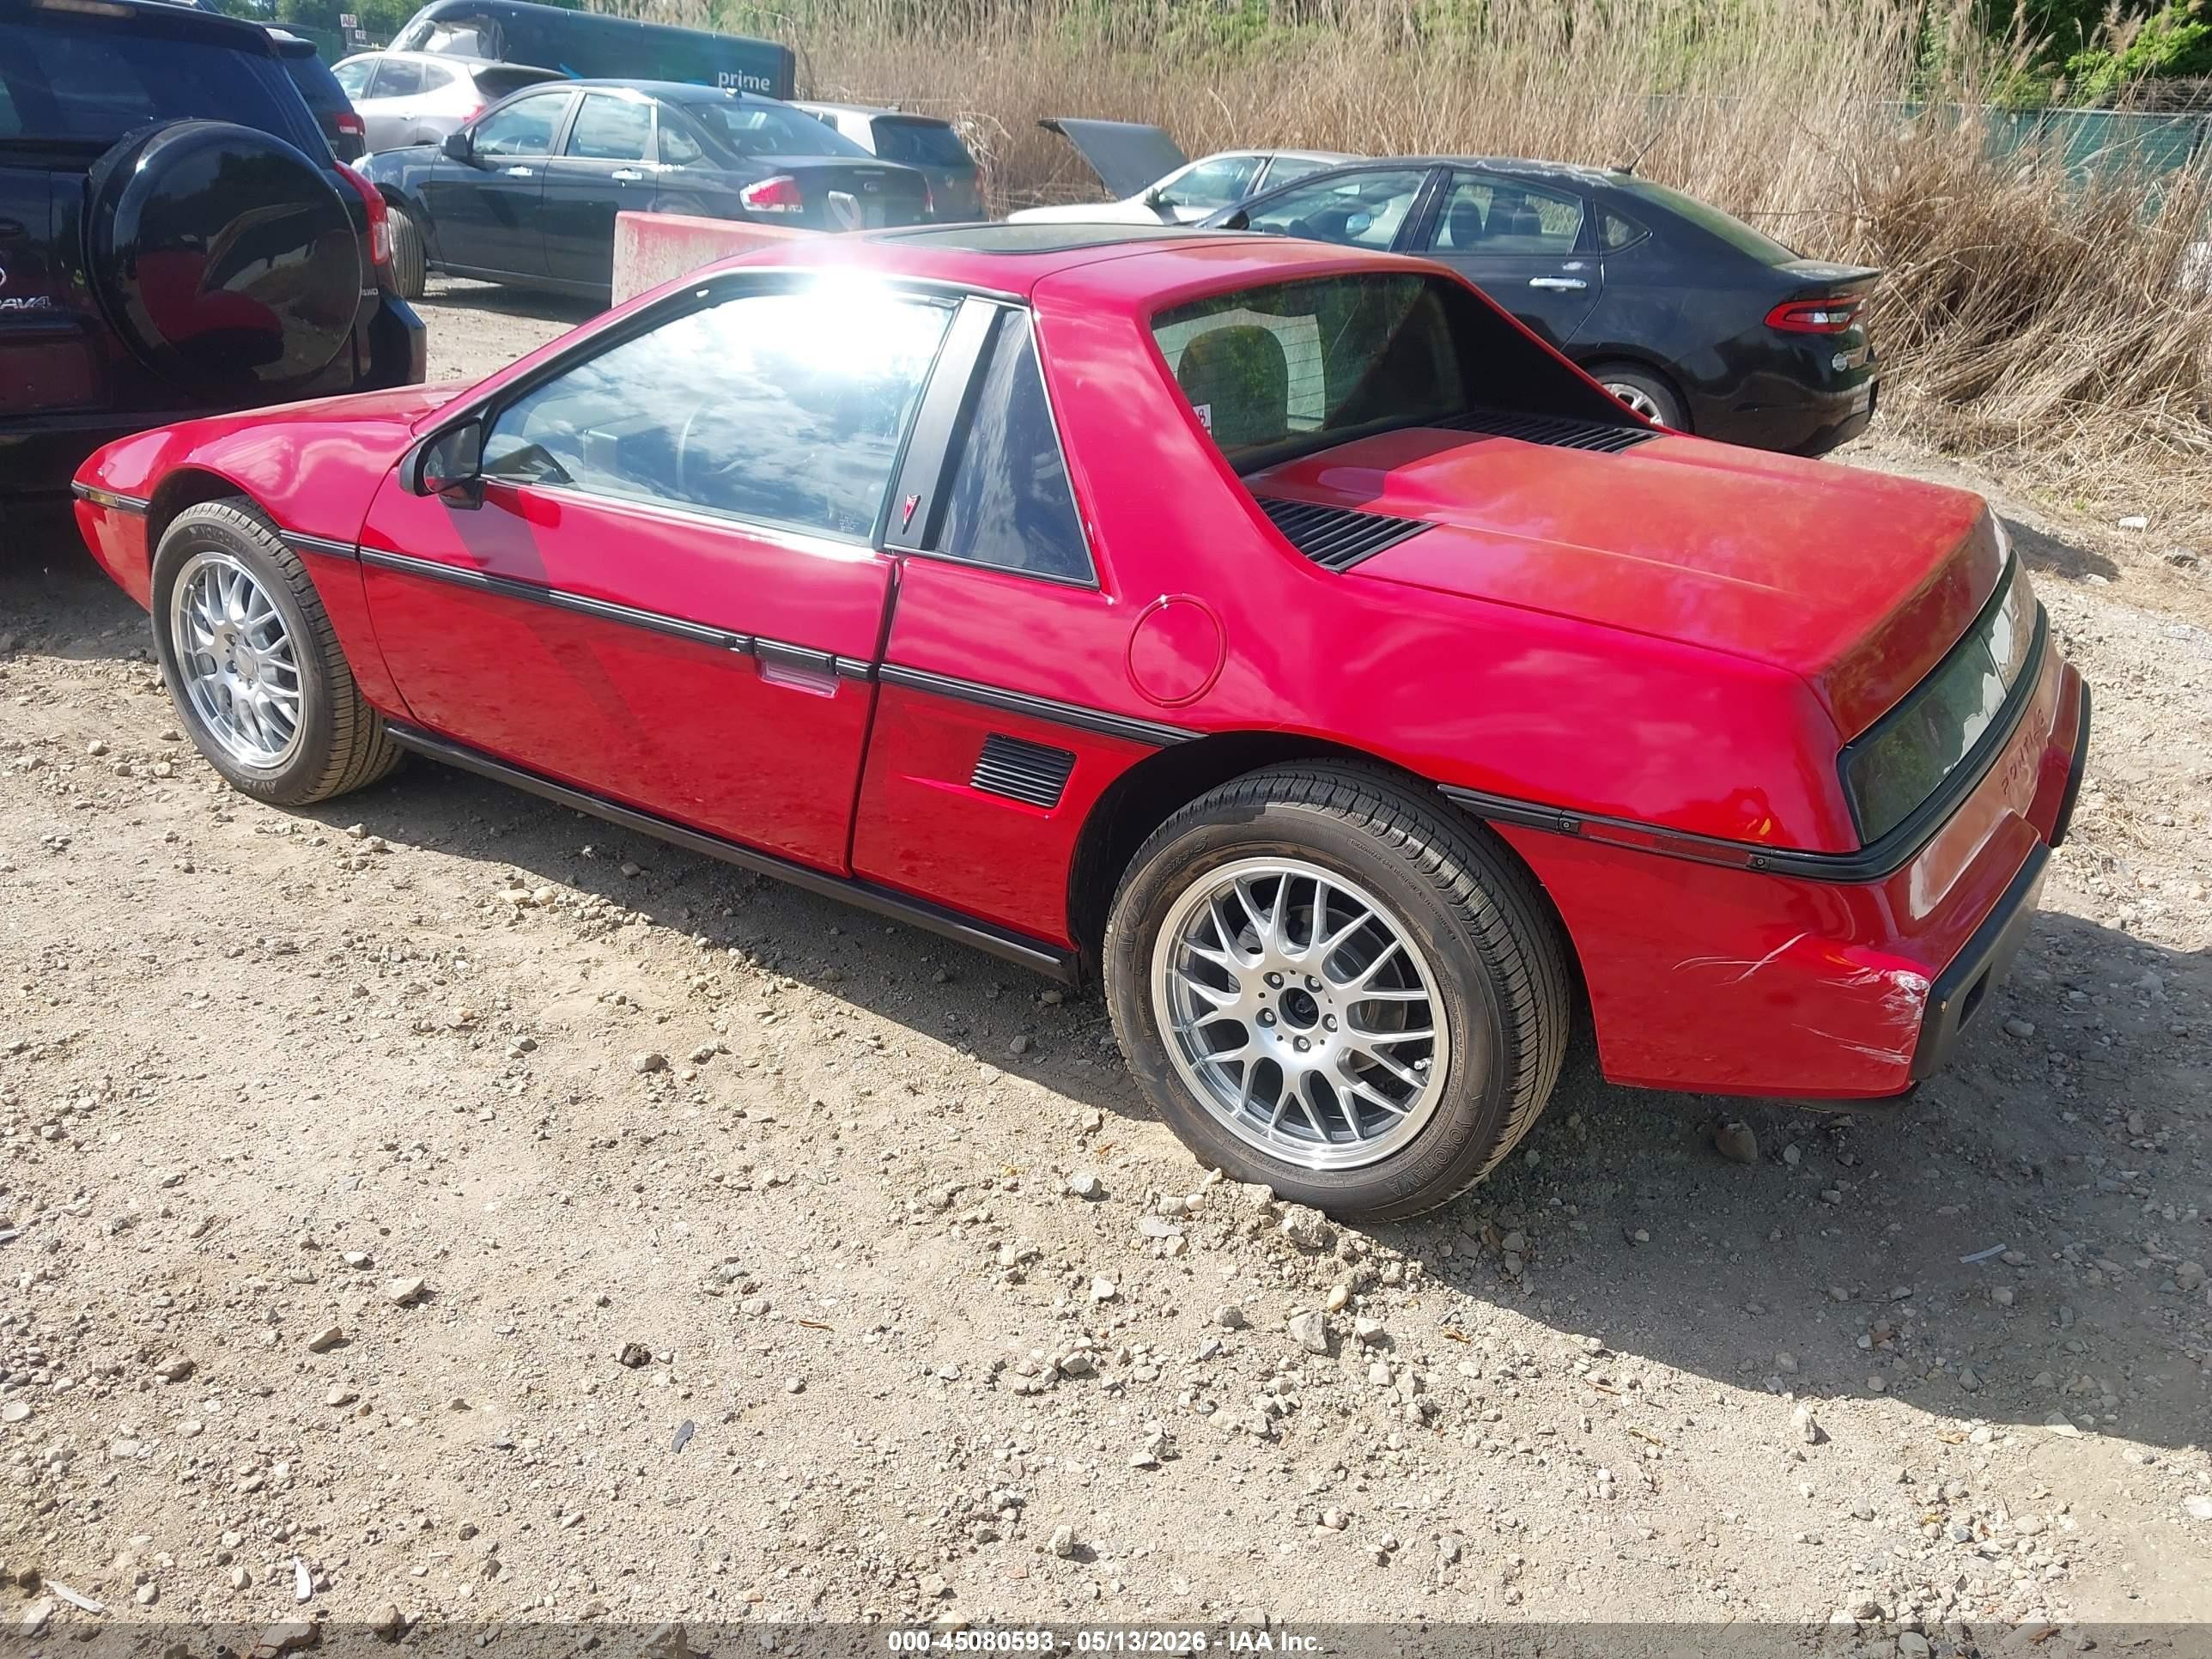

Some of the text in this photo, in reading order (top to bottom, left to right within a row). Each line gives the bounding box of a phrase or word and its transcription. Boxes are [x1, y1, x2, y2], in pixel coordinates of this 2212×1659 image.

[718, 69, 770, 92] prime
[0, 295, 52, 309] AV4
[1387, 1120, 1474, 1196] YOKOHAMA
